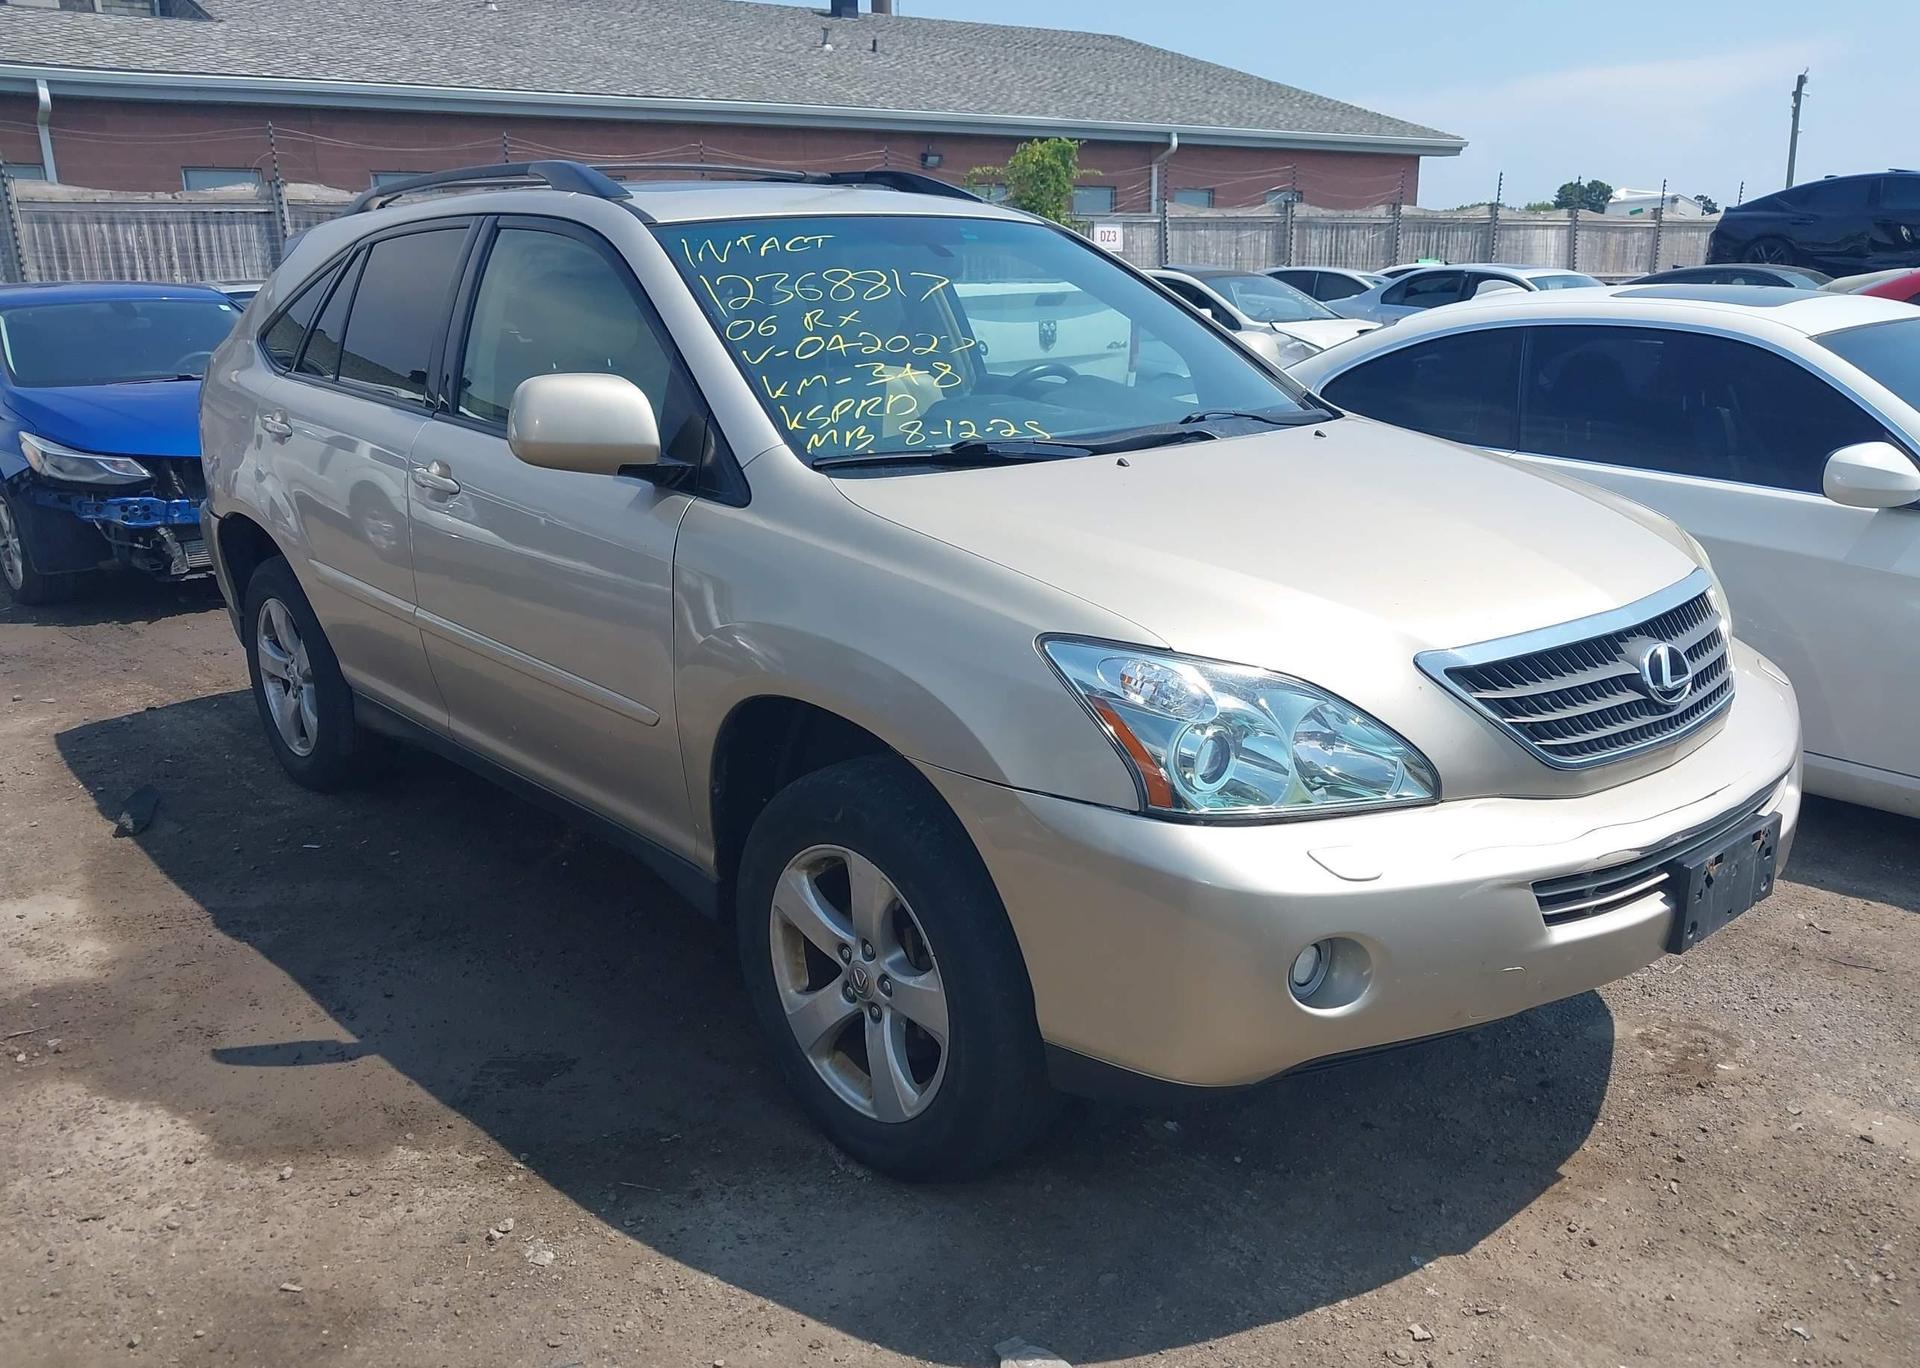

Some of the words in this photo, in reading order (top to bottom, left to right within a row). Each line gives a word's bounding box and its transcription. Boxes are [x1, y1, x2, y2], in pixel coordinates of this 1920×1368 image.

[681, 234, 837, 268] INTACT
[1100, 230, 1117, 242] DZ3
[699, 268, 950, 318] 12368817
[725, 315, 777, 341] 06
[802, 308, 862, 332] RX
[780, 394, 917, 431] KSPRD
